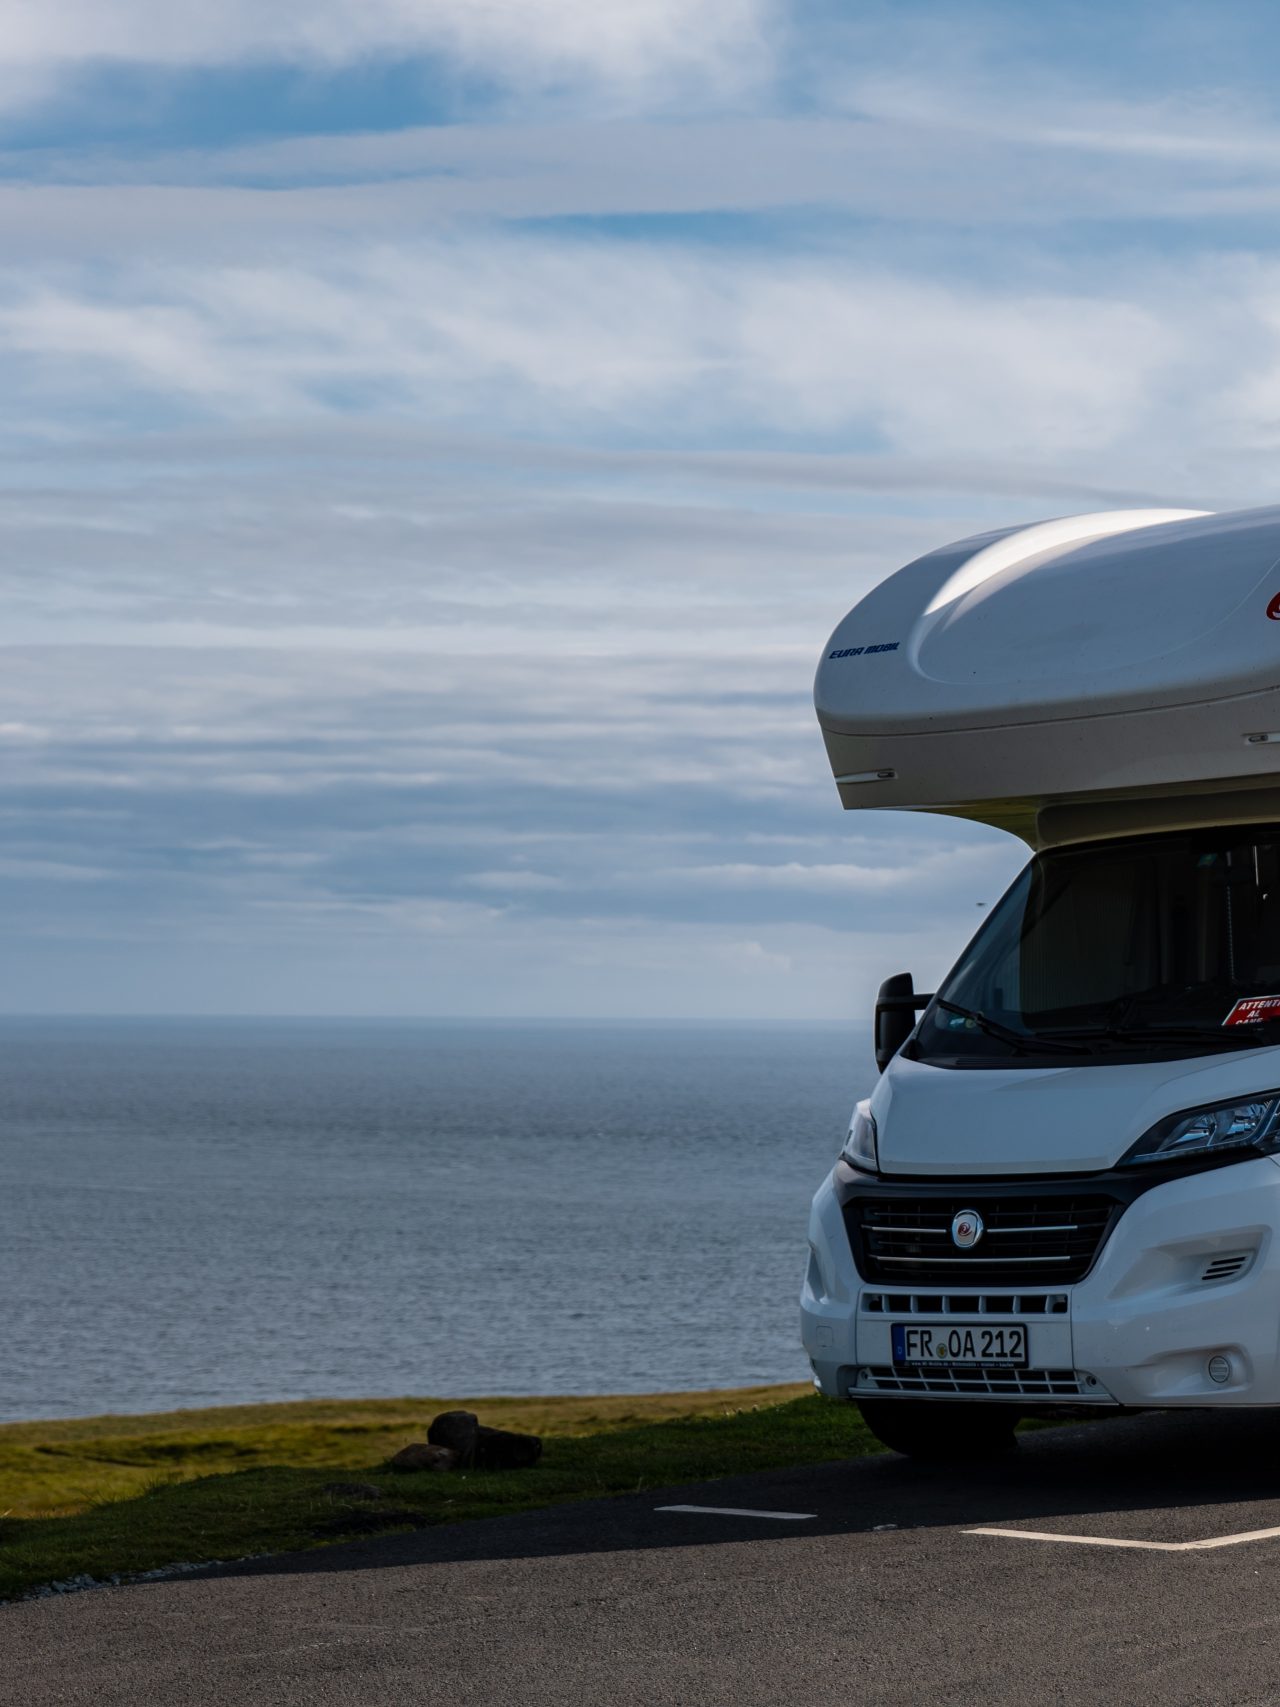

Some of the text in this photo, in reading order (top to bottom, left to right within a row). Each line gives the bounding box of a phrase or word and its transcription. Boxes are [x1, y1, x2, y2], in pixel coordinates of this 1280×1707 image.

[829, 642, 900, 659] EURA MOBIL
[1246, 1010, 1260, 1018] AL
[906, 1330, 1022, 1358] FR OA 212
